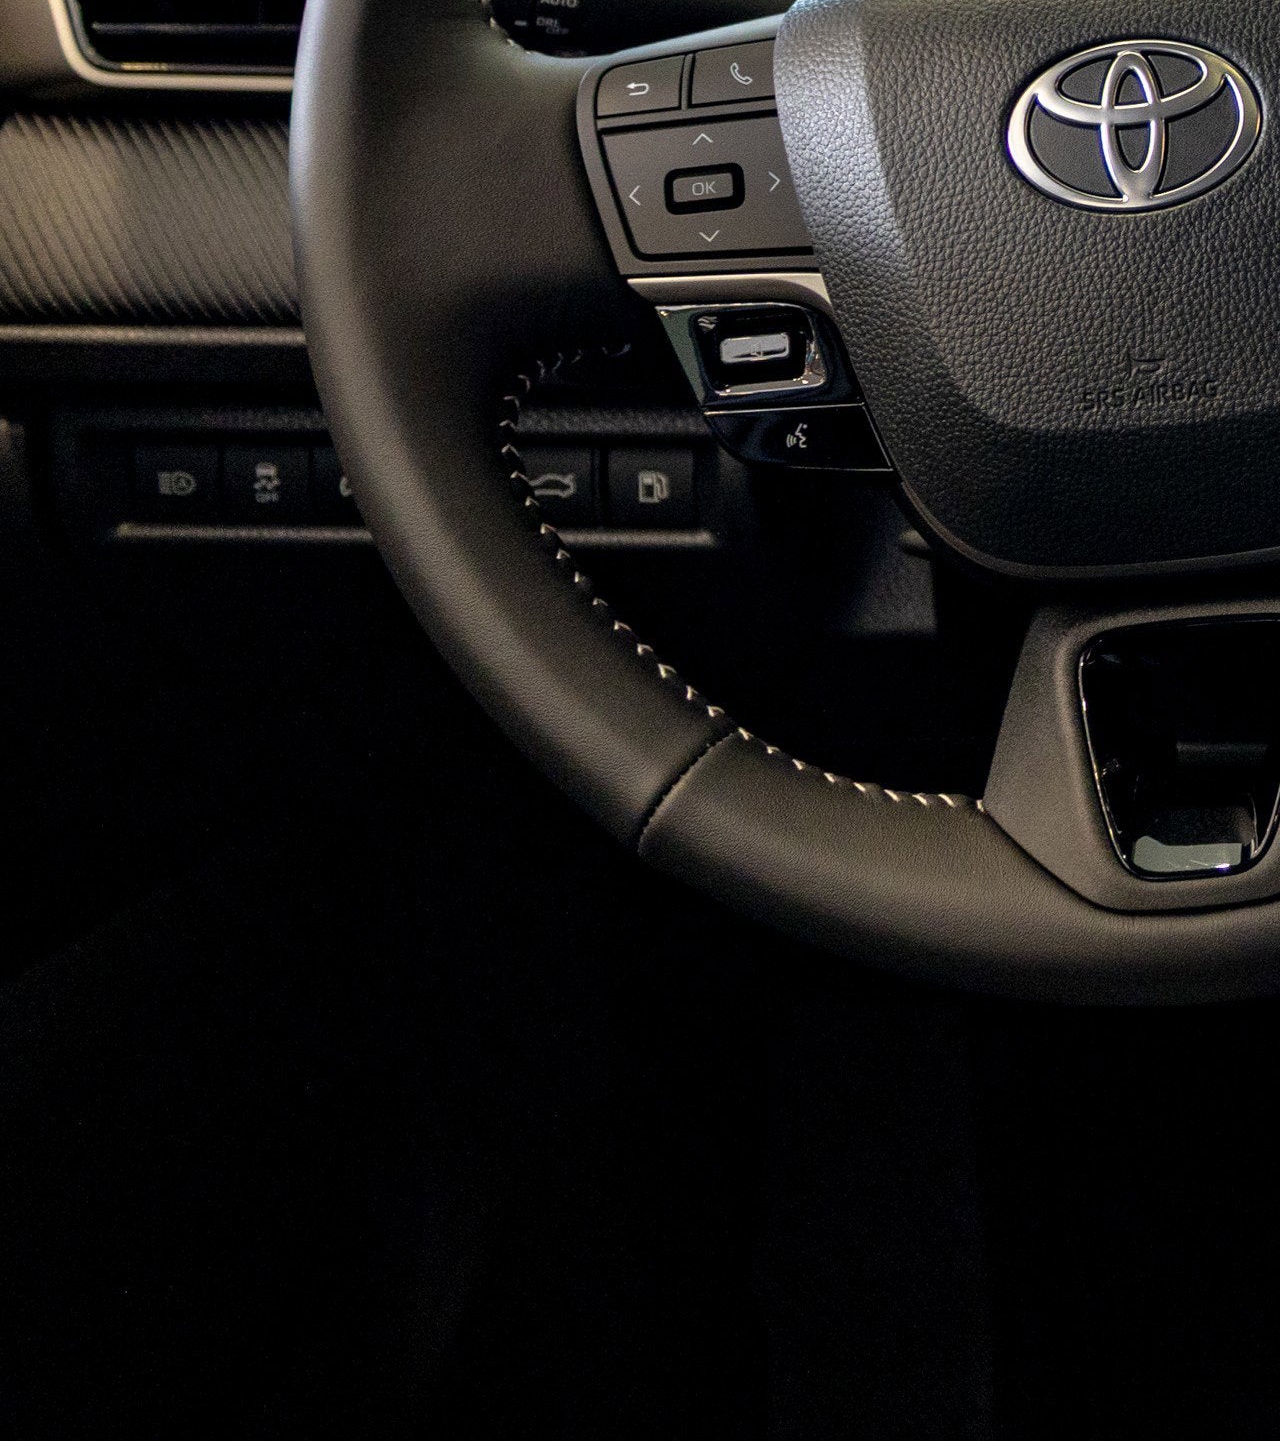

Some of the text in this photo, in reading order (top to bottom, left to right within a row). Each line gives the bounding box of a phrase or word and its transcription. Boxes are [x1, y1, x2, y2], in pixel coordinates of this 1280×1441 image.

[691, 179, 717, 197] OK
[1082, 379, 1223, 410] SRS AIRBAG
